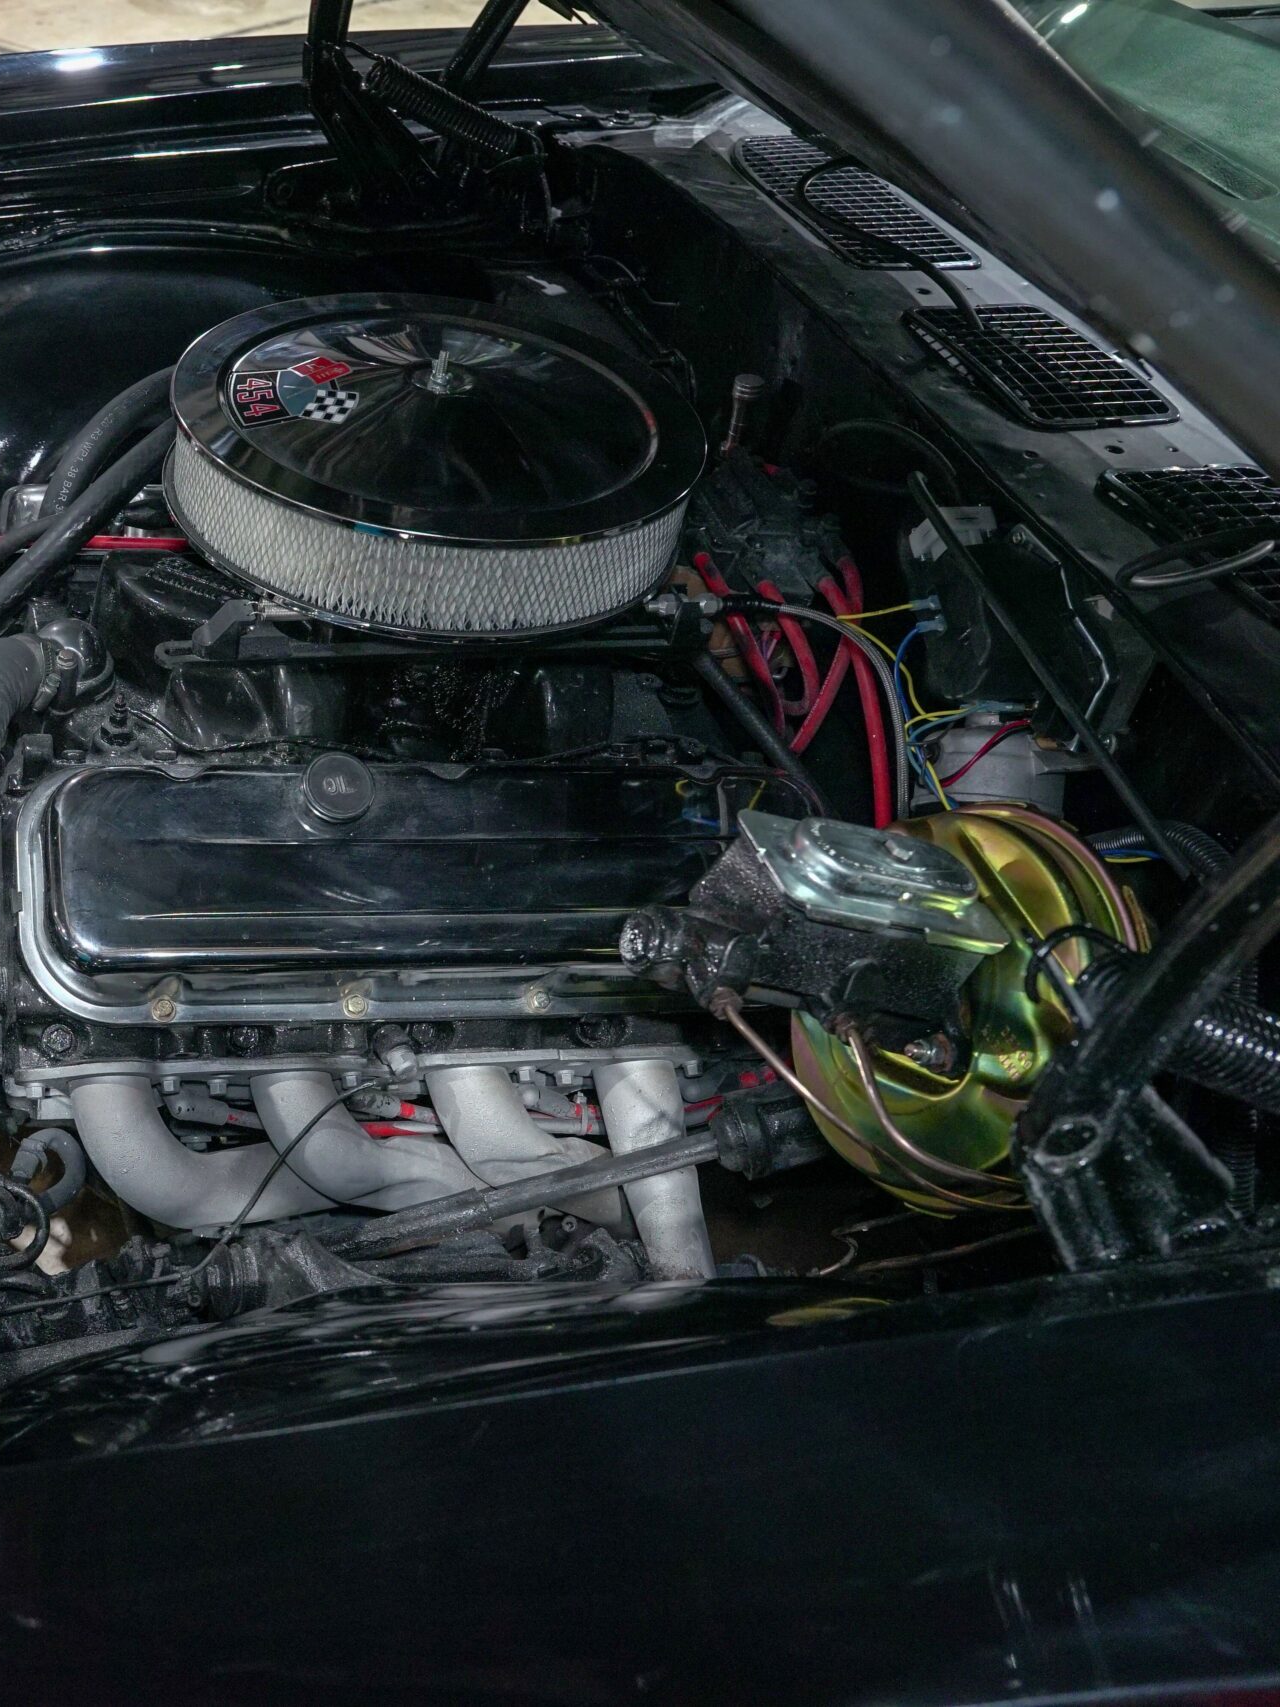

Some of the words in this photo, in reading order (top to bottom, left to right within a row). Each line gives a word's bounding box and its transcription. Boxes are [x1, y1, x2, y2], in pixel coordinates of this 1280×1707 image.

[237, 378, 280, 417] 454
[58, 480, 73, 502] BAR
[323, 775, 357, 795] OIL
